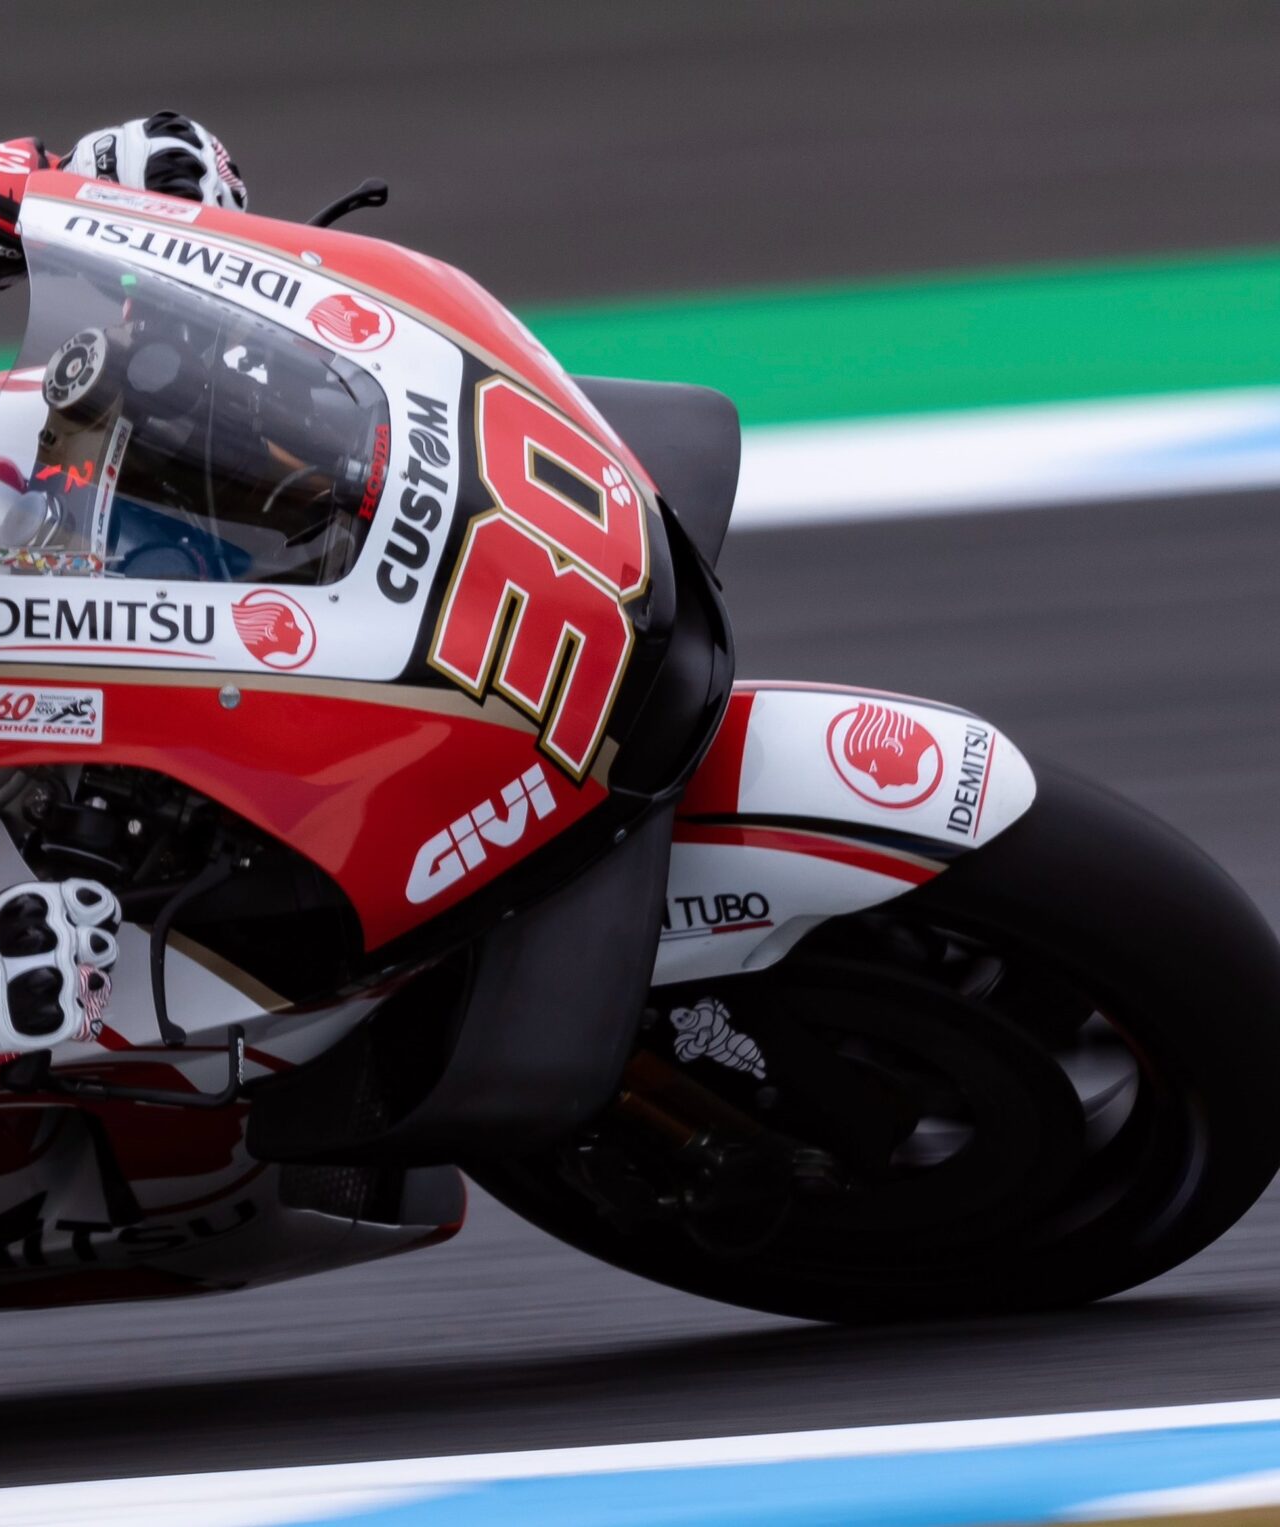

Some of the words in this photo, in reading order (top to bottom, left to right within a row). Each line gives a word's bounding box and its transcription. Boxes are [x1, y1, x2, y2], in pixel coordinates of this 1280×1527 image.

[64, 216, 302, 308] IDEMITSU
[357, 423, 389, 521] HONDA
[427, 374, 650, 783] 30
[405, 762, 557, 904] GIVI
[947, 724, 988, 834] IDEMITSU
